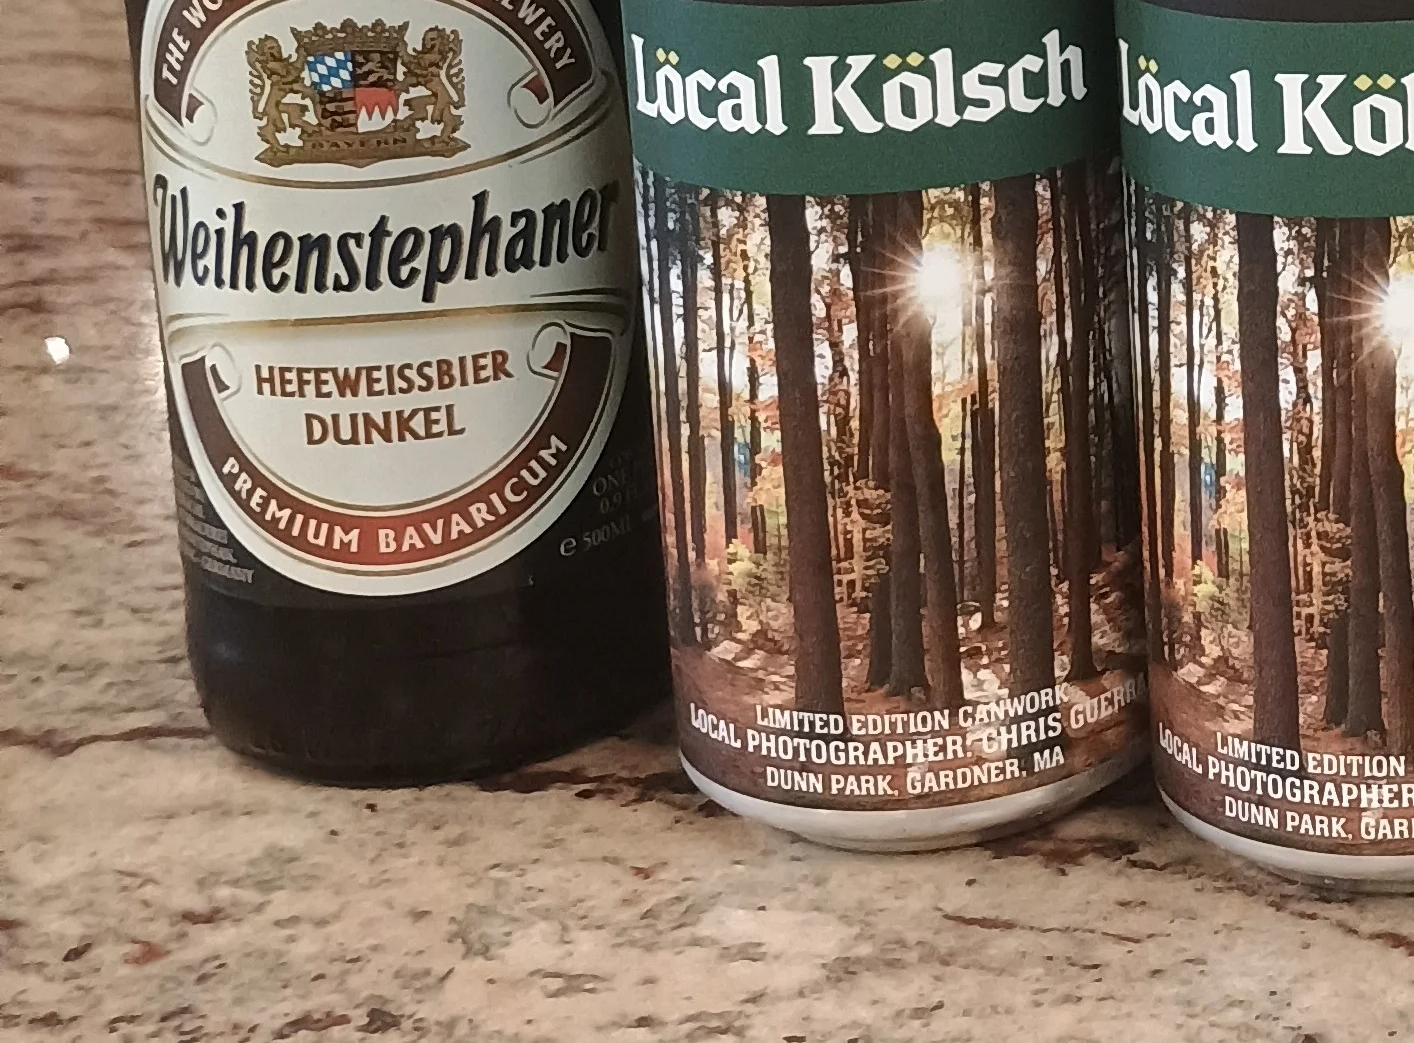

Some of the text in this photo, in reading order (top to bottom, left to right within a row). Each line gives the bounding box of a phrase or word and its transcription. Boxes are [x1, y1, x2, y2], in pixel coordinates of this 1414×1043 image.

[162, 28, 190, 86] THE
[631, 28, 1087, 136] Löcal Kölsch
[1118, 37, 1258, 152] Löcal
[154, 173, 620, 303] Weihenstephaner
[255, 349, 514, 398] HEFEWEISSBIER
[305, 404, 466, 445] DUNKEL
[221, 433, 569, 554] PREMIUM BAVARICUM
[689, 703, 742, 748] LOCAL
[747, 730, 973, 766] PHOTOGRAPHER:
[982, 712, 1062, 754] CHRIS
[755, 684, 1069, 736] LIMITED EDITION CANWORK
[766, 767, 823, 794] DUNN
[830, 773, 899, 797] PARK,
[1033, 745, 1065, 772] MA
[1159, 722, 1202, 773] LOCAL
[1216, 731, 1300, 770] LIMITED
[1307, 749, 1405, 777] EDITION
[1224, 796, 1278, 829] DUNN
[1286, 811, 1353, 841] PARK,
